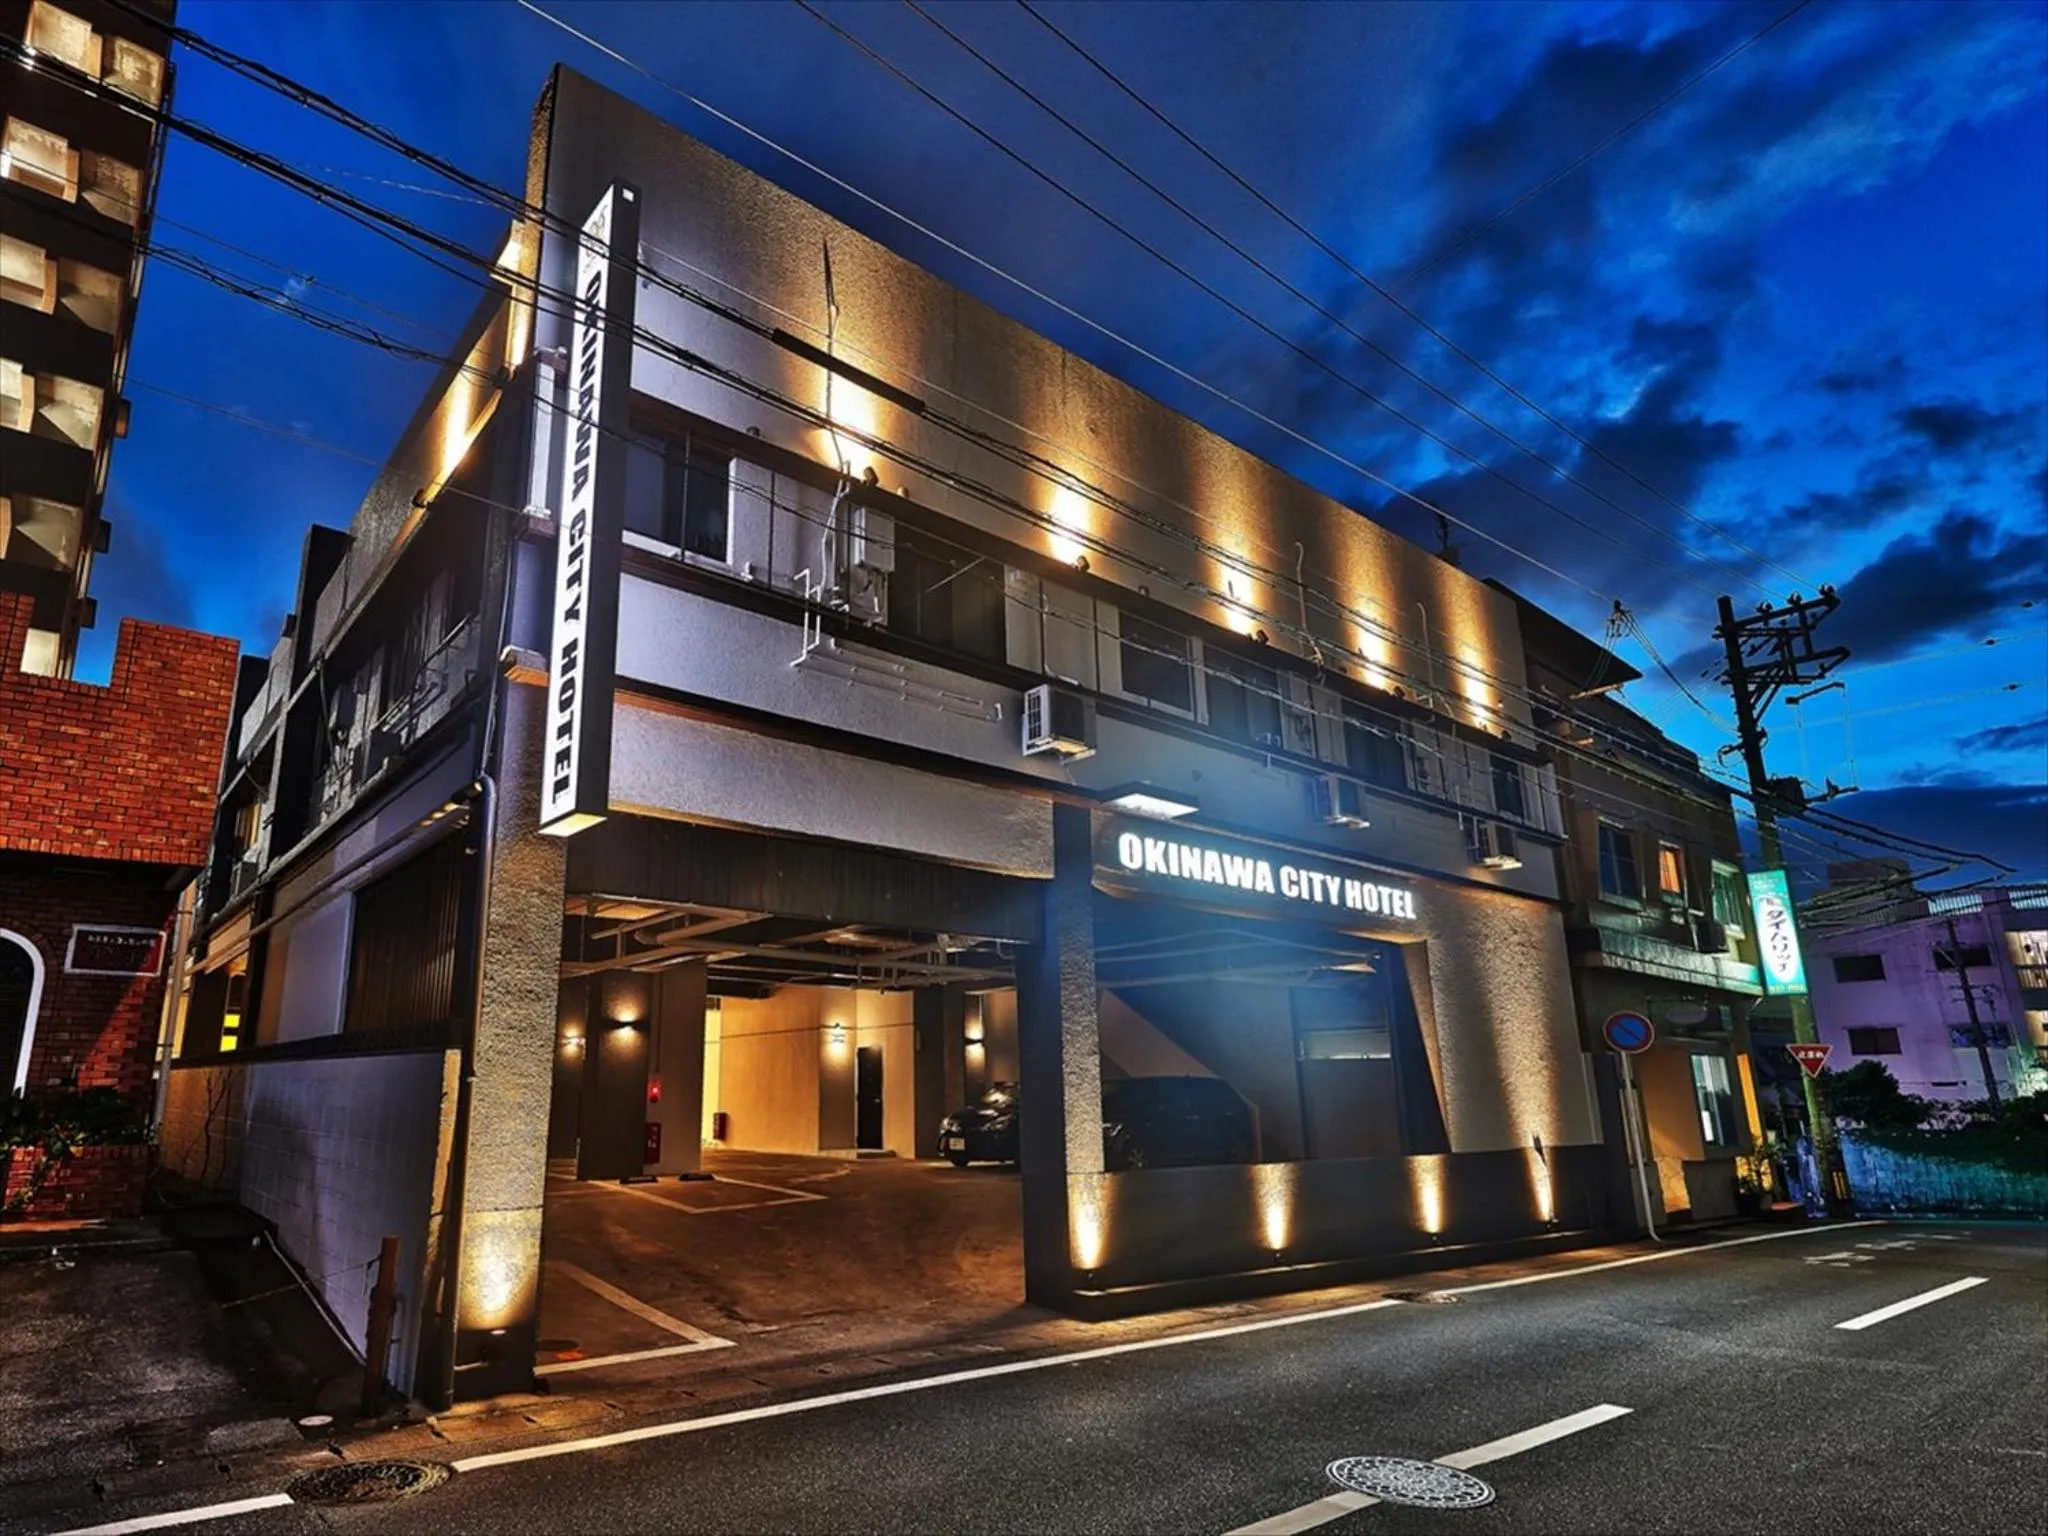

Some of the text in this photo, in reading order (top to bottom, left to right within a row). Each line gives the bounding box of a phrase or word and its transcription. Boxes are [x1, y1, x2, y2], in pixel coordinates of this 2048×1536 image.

[573, 270, 602, 502] OKINAWA
[564, 508, 587, 623] CITY
[552, 637, 579, 805] HOTEL
[1118, 832, 1417, 920] OKINAWA CITY HOTEL
